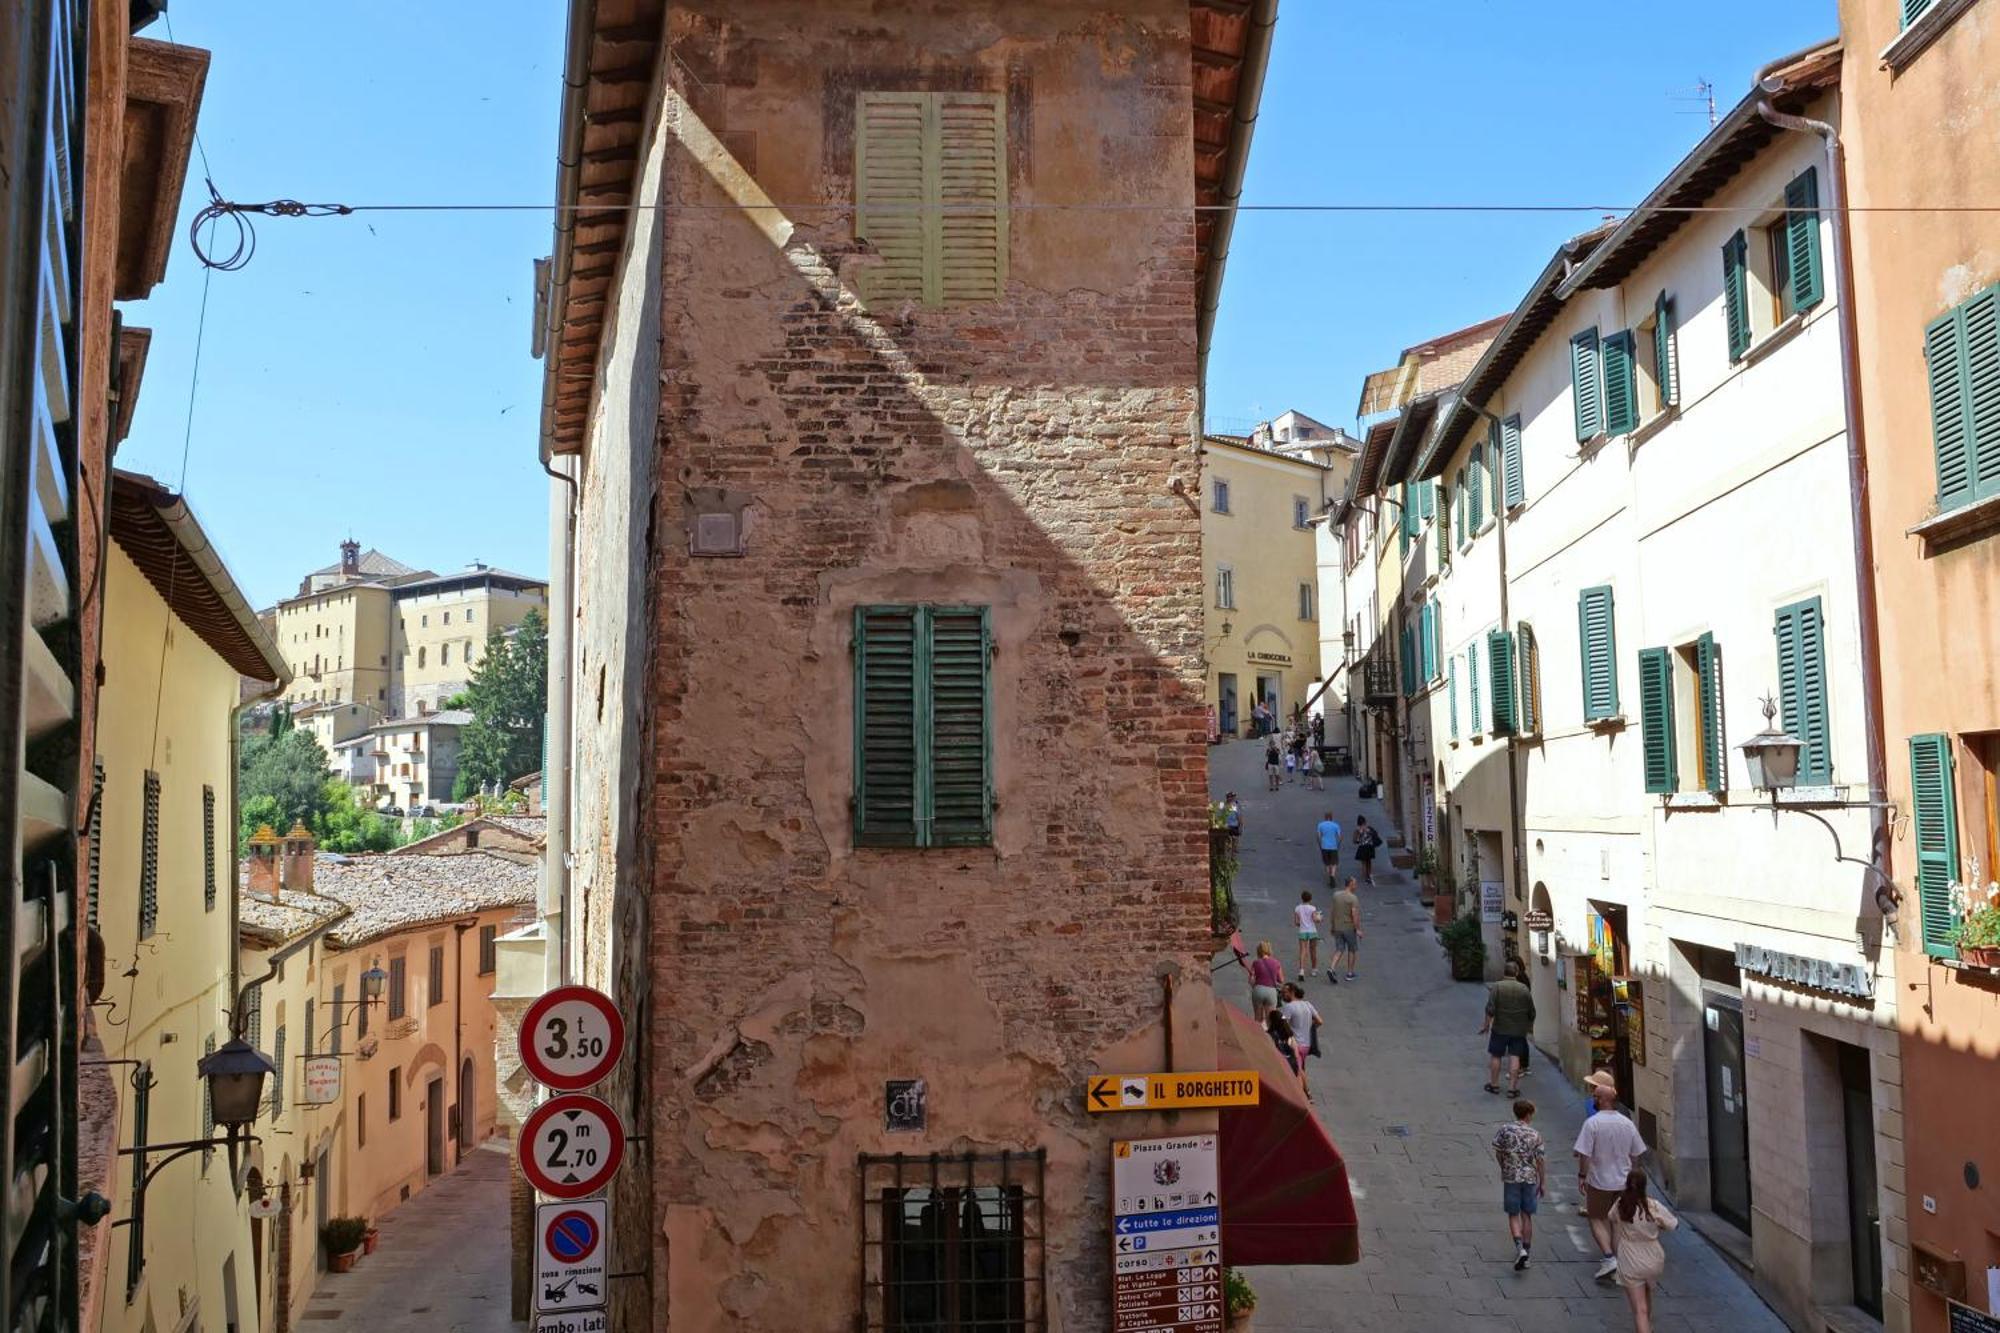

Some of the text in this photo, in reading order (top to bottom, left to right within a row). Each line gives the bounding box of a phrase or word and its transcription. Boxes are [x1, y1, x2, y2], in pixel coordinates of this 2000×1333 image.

[1154, 1080, 1253, 1099] IL BORGHETTO
[576, 1125, 590, 1138] m
[1133, 1141, 1198, 1153] Piazza Grande
[1133, 1212, 1217, 1229] tutte le direzioni
[1118, 1259, 1148, 1269] corso
[583, 1317, 605, 1332] lati
